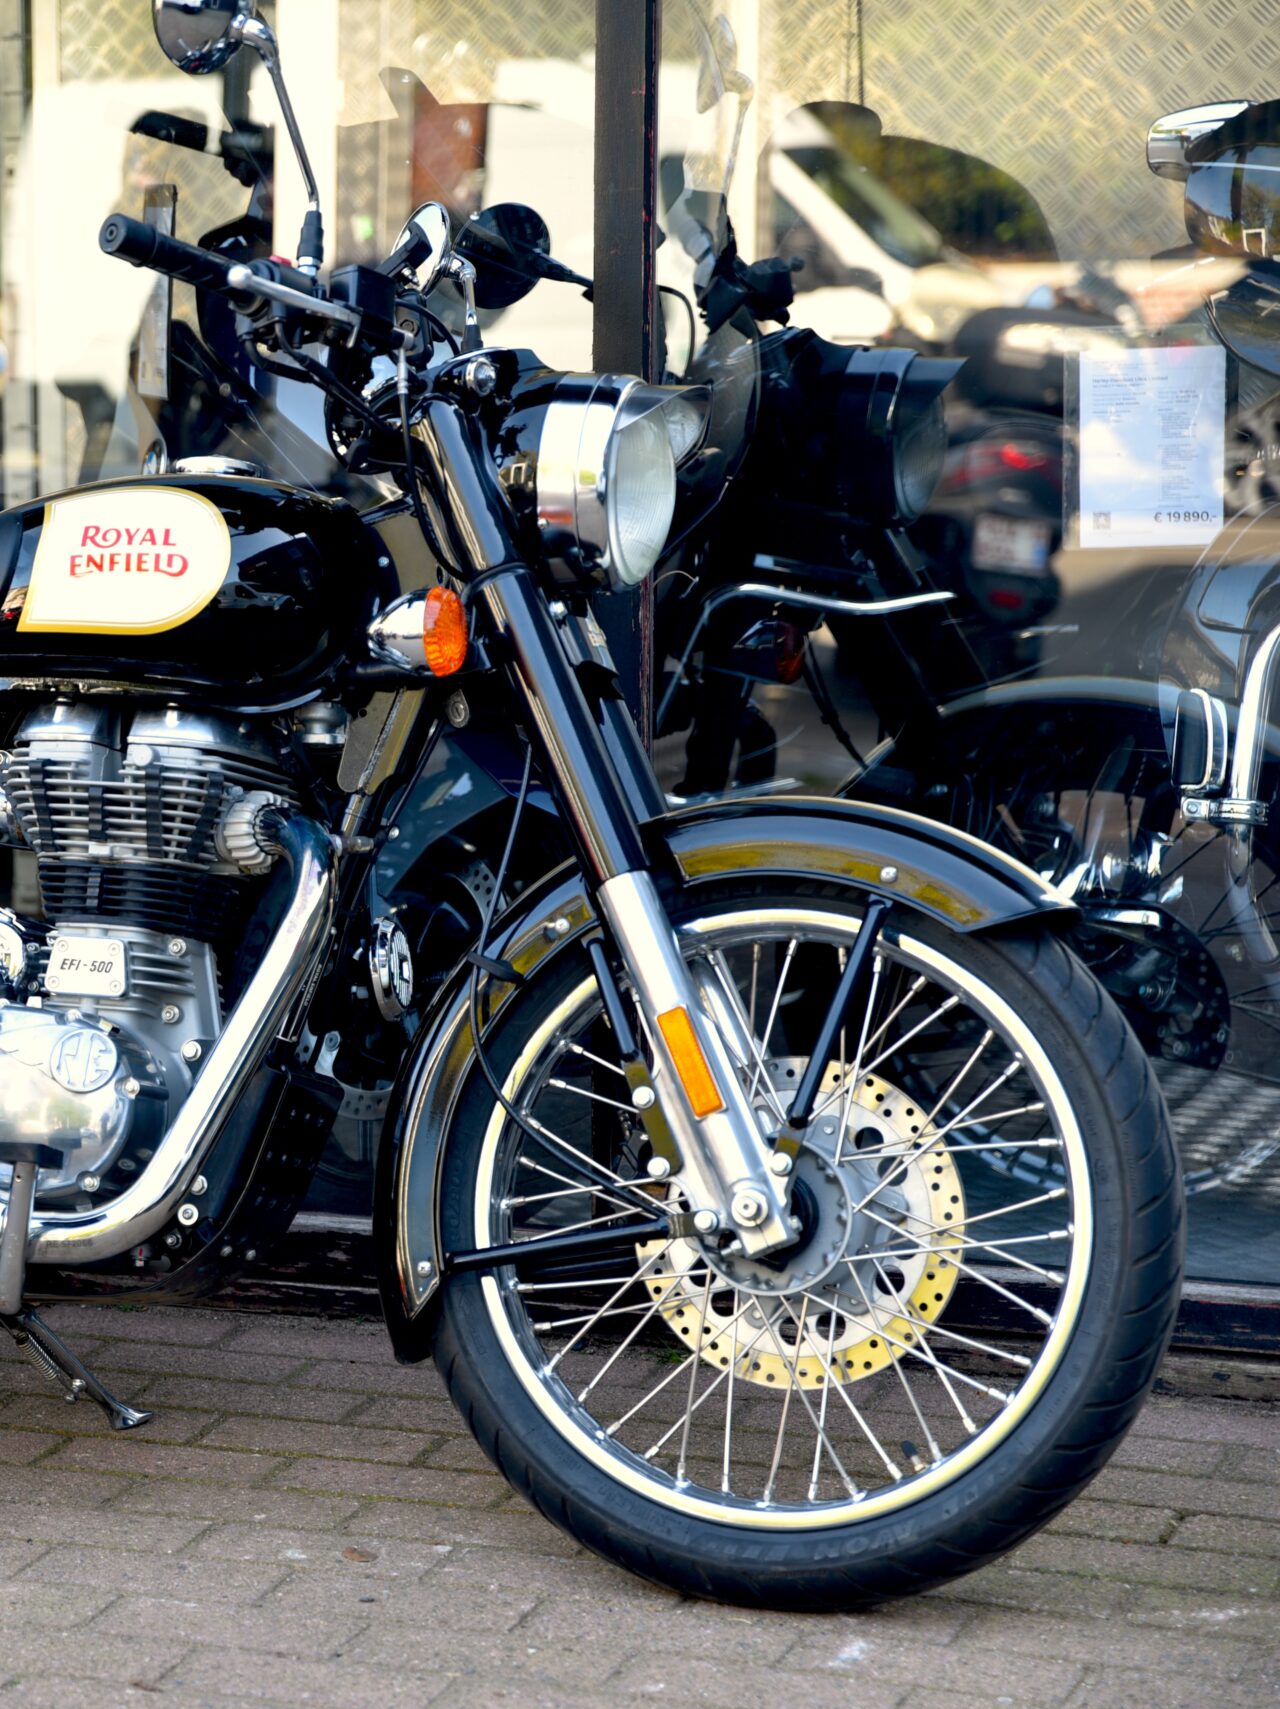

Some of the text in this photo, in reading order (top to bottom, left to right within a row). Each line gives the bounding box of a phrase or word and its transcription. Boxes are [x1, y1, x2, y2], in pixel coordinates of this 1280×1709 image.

[1154, 511, 1162, 523] €
[80, 525, 176, 549] ROYAL
[70, 552, 189, 578] ENFIELD
